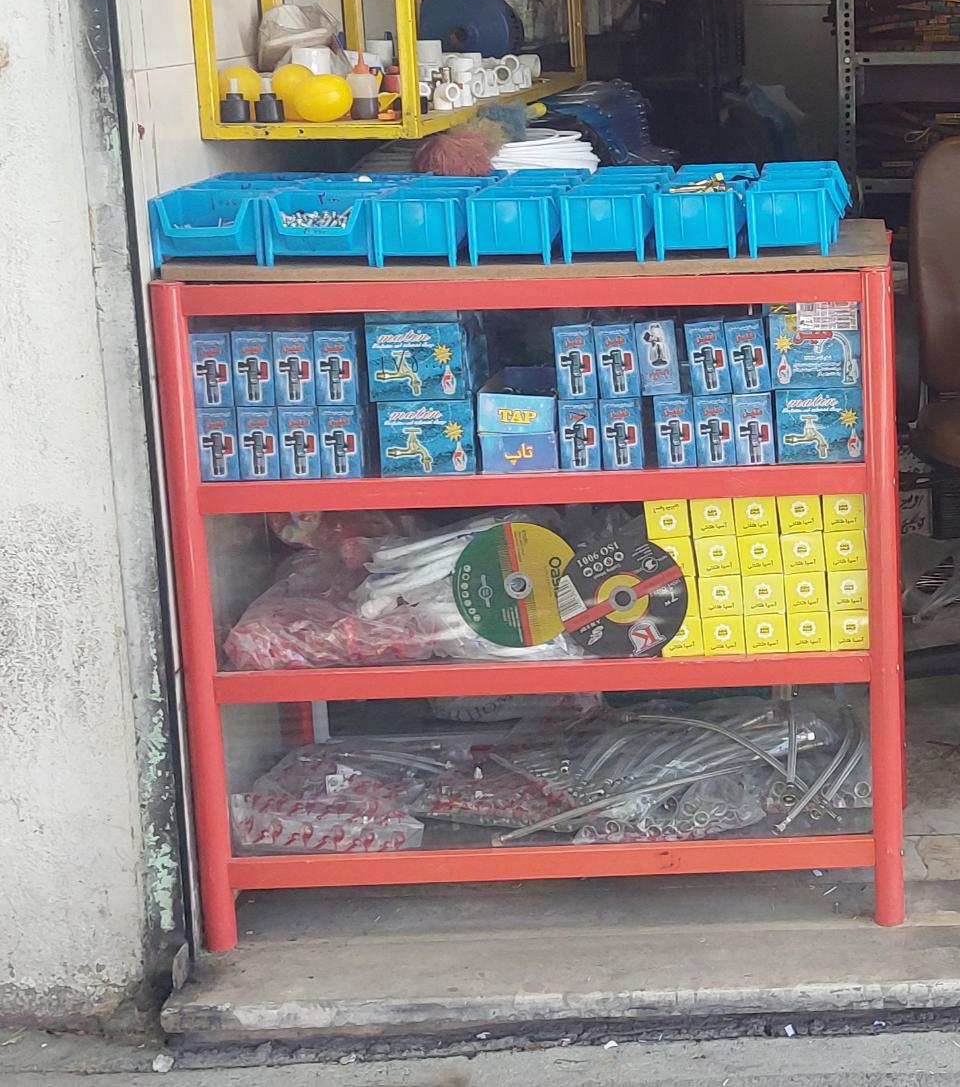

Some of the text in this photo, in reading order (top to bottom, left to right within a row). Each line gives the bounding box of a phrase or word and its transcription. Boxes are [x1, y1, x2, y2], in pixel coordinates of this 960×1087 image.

[497, 408, 538, 424] TAP
[504, 443, 534, 466] تاپ
[576, 542, 619, 568] ISO 9001
